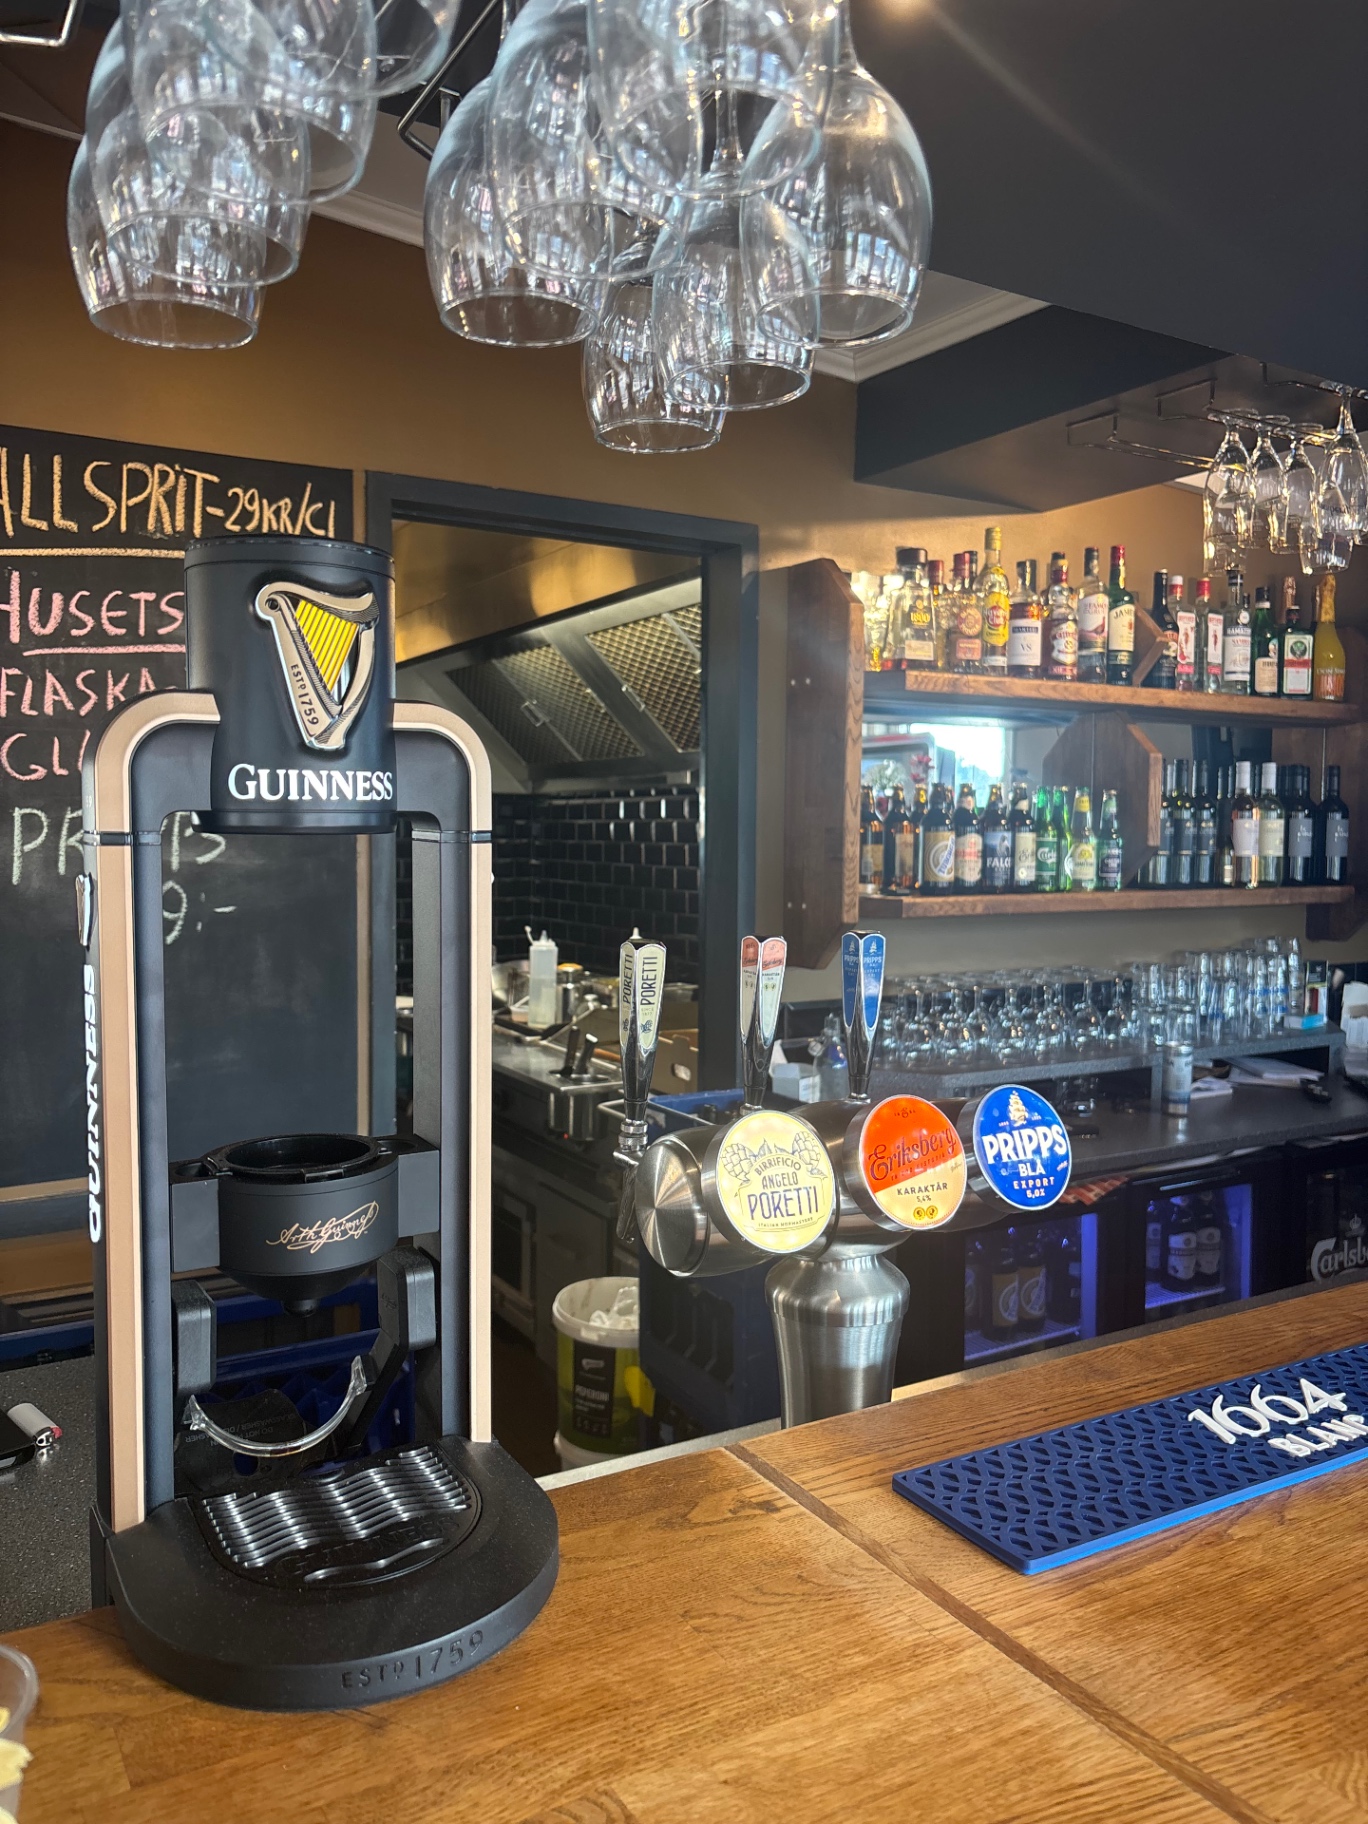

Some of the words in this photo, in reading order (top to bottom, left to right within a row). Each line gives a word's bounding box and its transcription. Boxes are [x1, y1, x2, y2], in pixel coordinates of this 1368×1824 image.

[298, 692, 319, 725] 1759
[228, 763, 393, 801] GUINNESS
[623, 954, 633, 1004] PORETTI
[640, 956, 658, 1005] PORETTI
[84, 964, 100, 1243] GUINNESS
[868, 1128, 957, 1181] Eriksberg
[981, 1124, 1067, 1165] PRIPPS
[754, 1157, 802, 1176] BIRRIFICIO
[761, 1171, 799, 1190] ANGELO
[1013, 1177, 1055, 1190] EXPORT
[747, 1186, 819, 1221] PORETTI
[897, 1183, 948, 1196] KARAKTÄR
[1026, 1189, 1046, 1198] 5,0%
[1187, 1378, 1348, 1445] 1664
[415, 1630, 484, 1679] 1759
